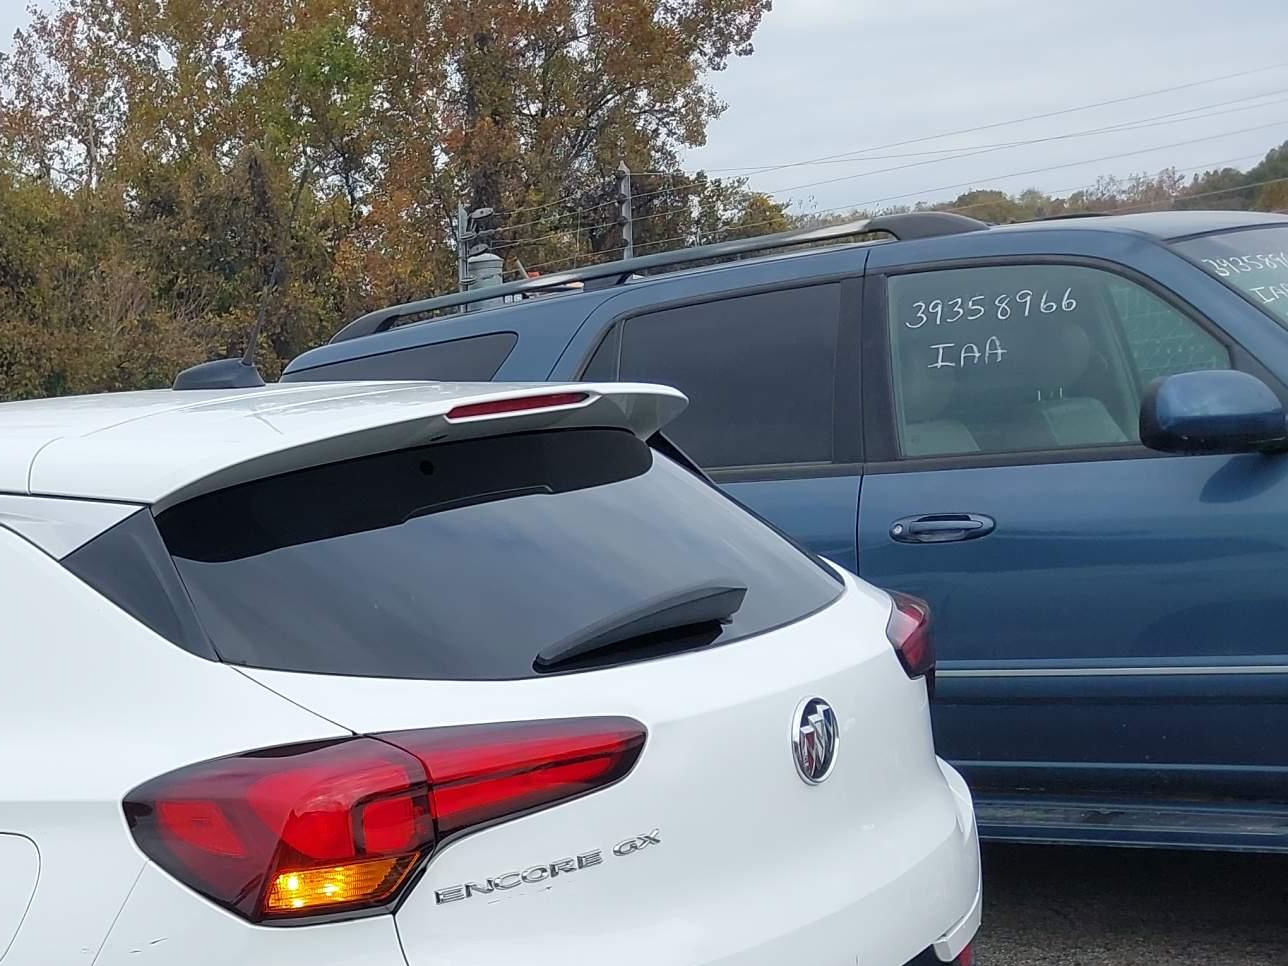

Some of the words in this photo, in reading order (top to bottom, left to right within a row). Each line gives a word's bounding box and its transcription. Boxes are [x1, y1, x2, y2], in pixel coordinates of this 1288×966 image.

[927, 335, 1008, 369] IAA
[434, 849, 603, 905] ENCORE
[612, 827, 661, 857] GX
